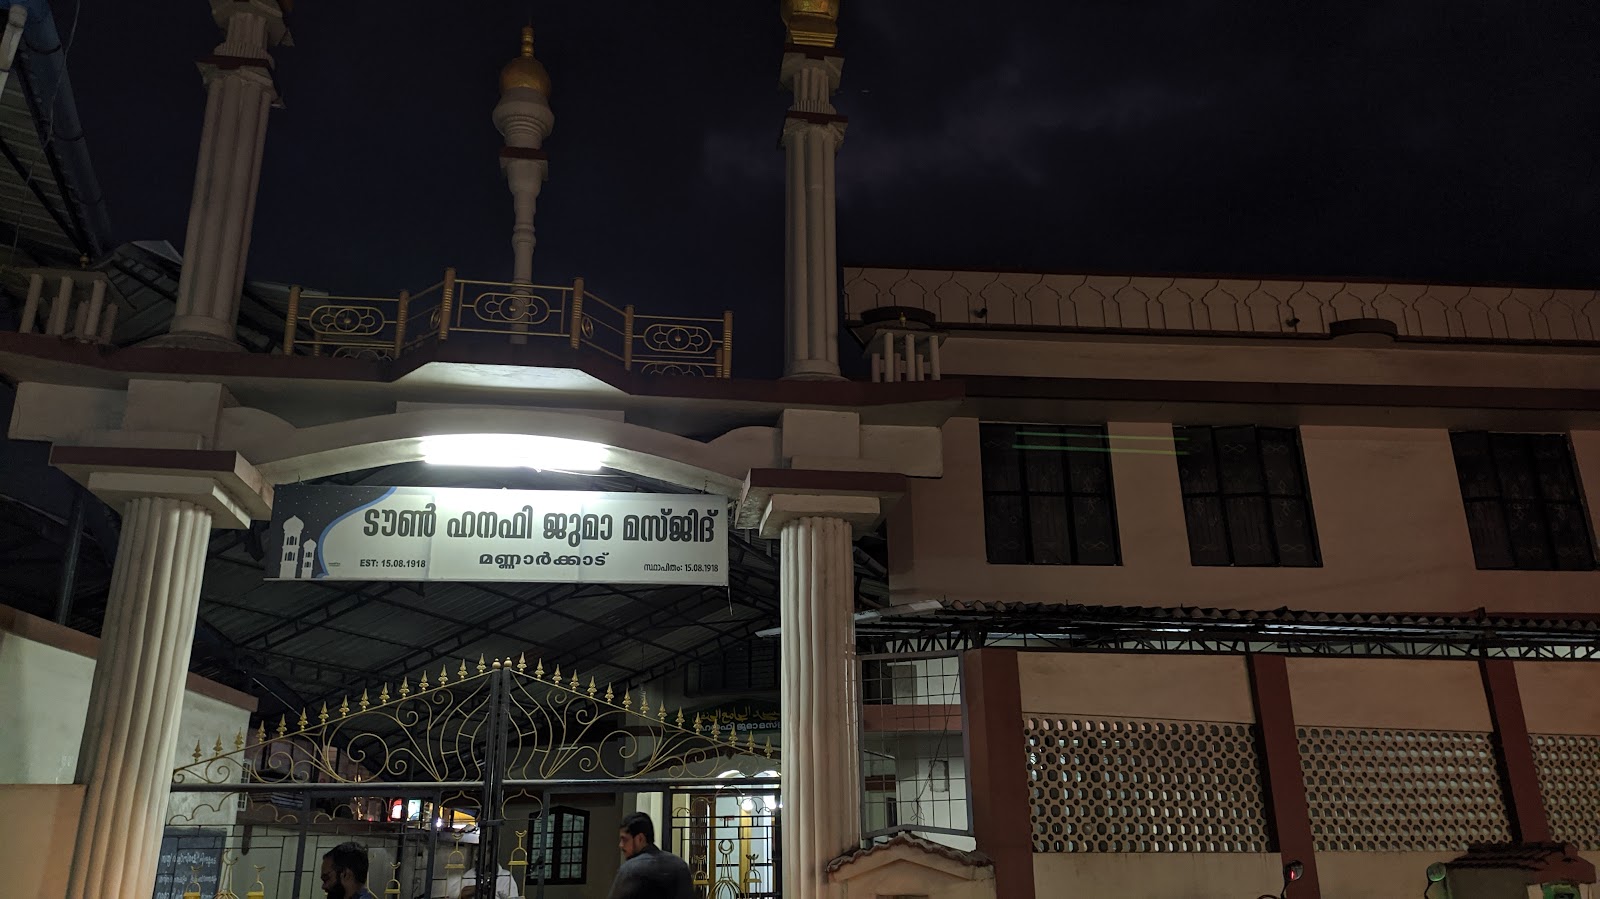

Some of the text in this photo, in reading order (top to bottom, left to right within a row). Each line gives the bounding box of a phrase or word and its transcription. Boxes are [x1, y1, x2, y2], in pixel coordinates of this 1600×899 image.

[363, 502, 719, 547] ടൗൺ ഹനഫി ജുമാ മസ്ജിദ്
[359, 559, 426, 568] EST: 15.08.1918
[479, 551, 610, 569] മണ്ണാർക്കാട്
[684, 563, 719, 572] 15.08.1918
